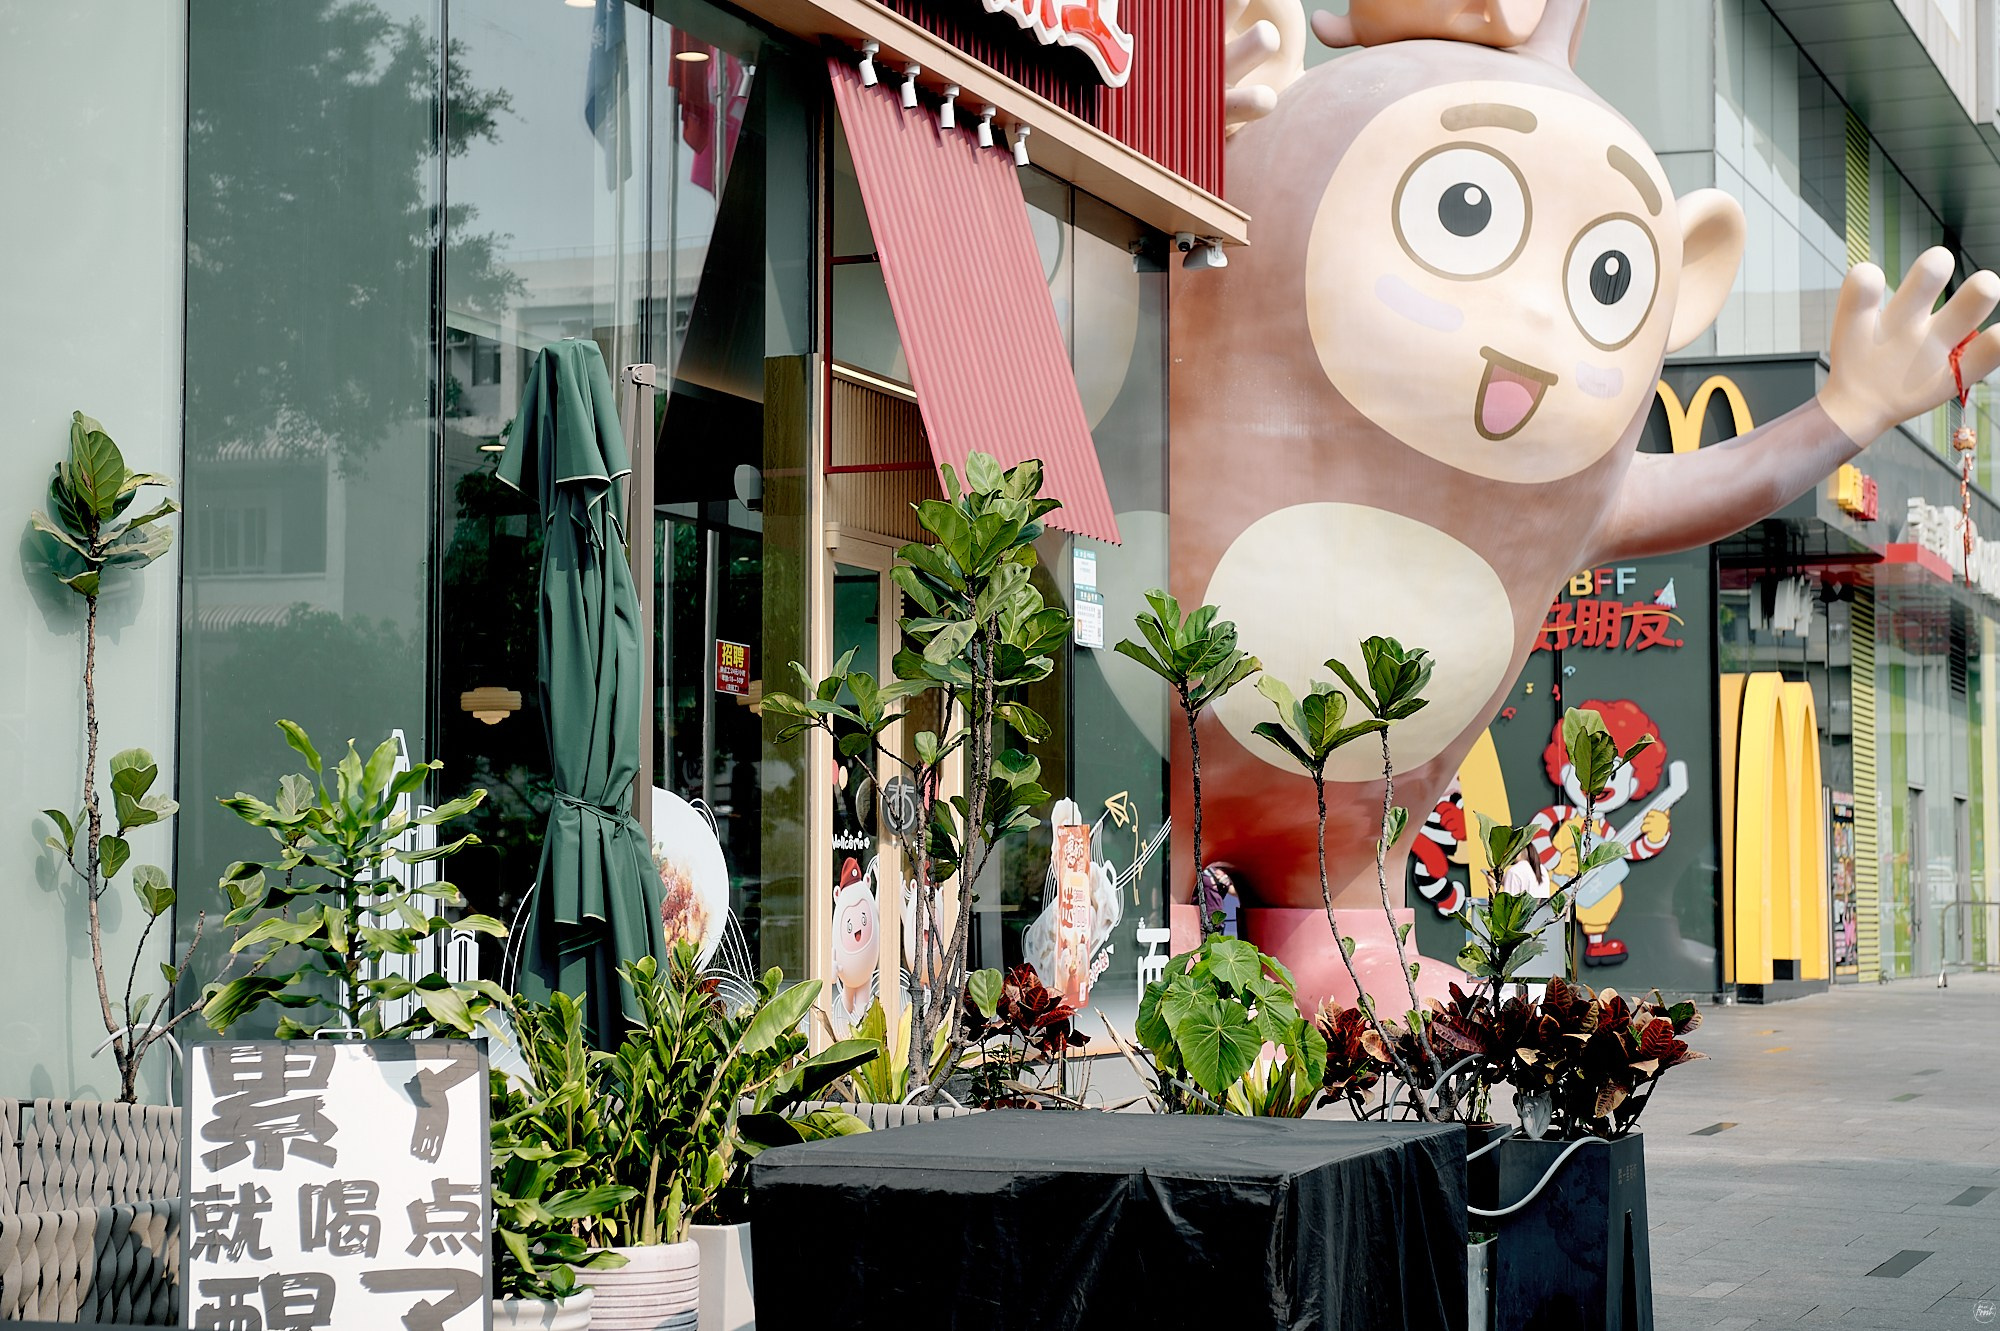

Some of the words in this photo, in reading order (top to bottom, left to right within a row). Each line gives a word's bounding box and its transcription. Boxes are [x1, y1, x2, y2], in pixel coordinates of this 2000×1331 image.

[1569, 567, 1637, 596] BFF
[722, 642, 745, 668] 招聘
[189, 1178, 484, 1264] 就喝点
